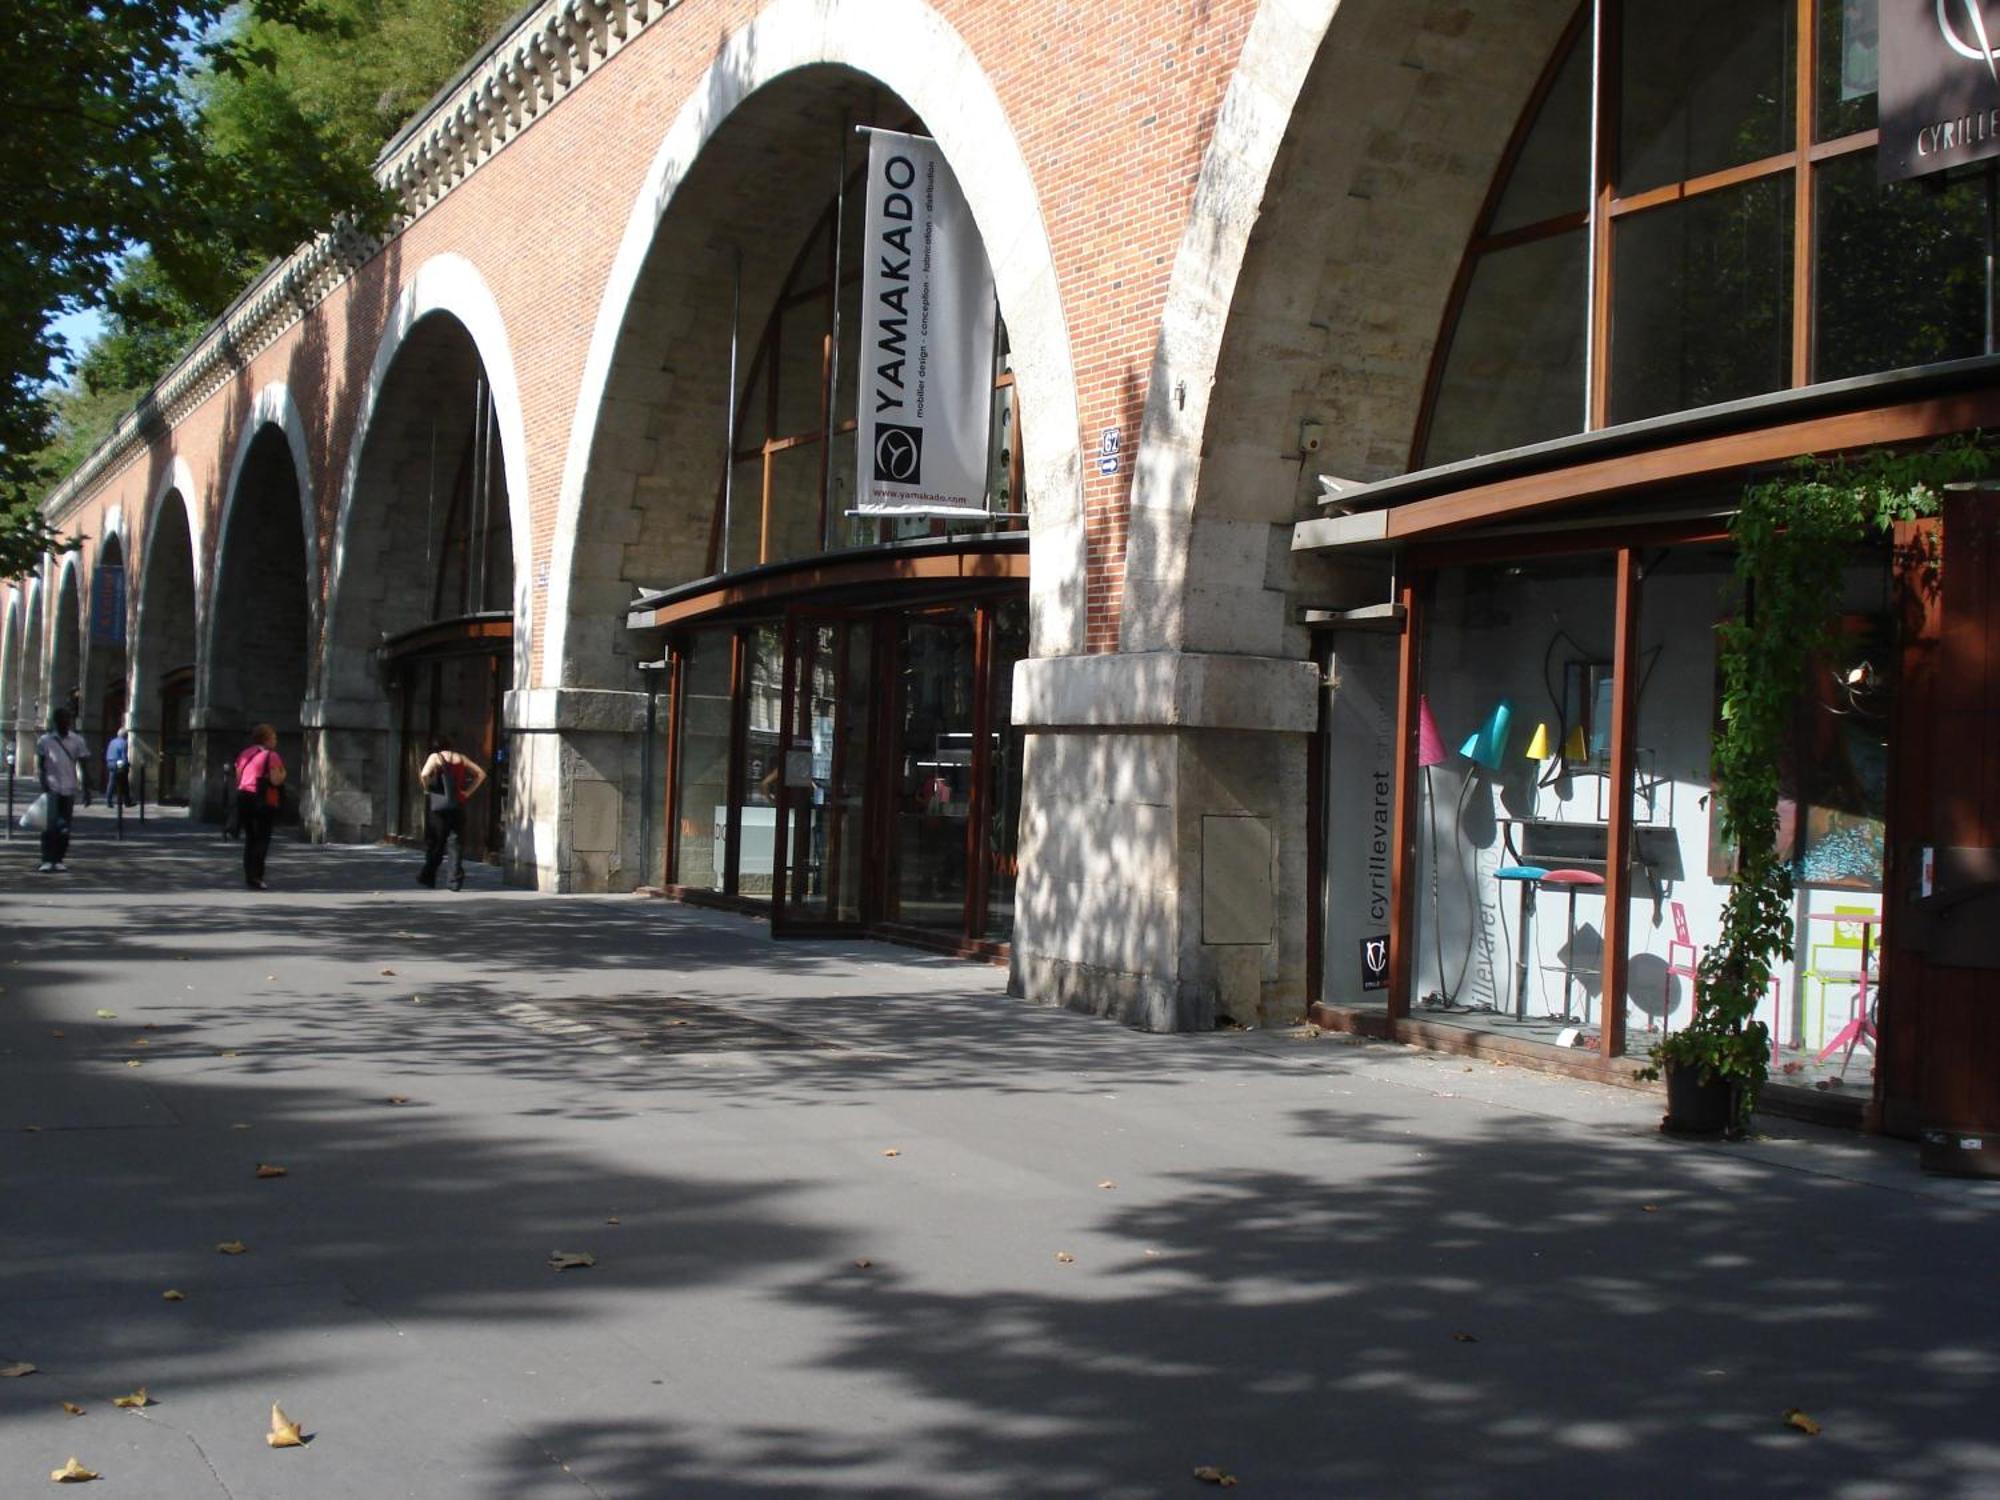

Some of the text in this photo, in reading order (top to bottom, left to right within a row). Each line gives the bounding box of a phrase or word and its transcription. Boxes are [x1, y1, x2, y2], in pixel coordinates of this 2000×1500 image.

[1918, 108, 2000, 156] CYRILLE
[926, 161, 935, 212] distribution
[923, 222, 932, 272] fabrication
[876, 156, 915, 413] YAMAKADO
[921, 282, 930, 336] conception
[919, 345, 928, 377] design
[917, 380, 925, 418] mobilier
[873, 489, 967, 504] www.yamakado.com
